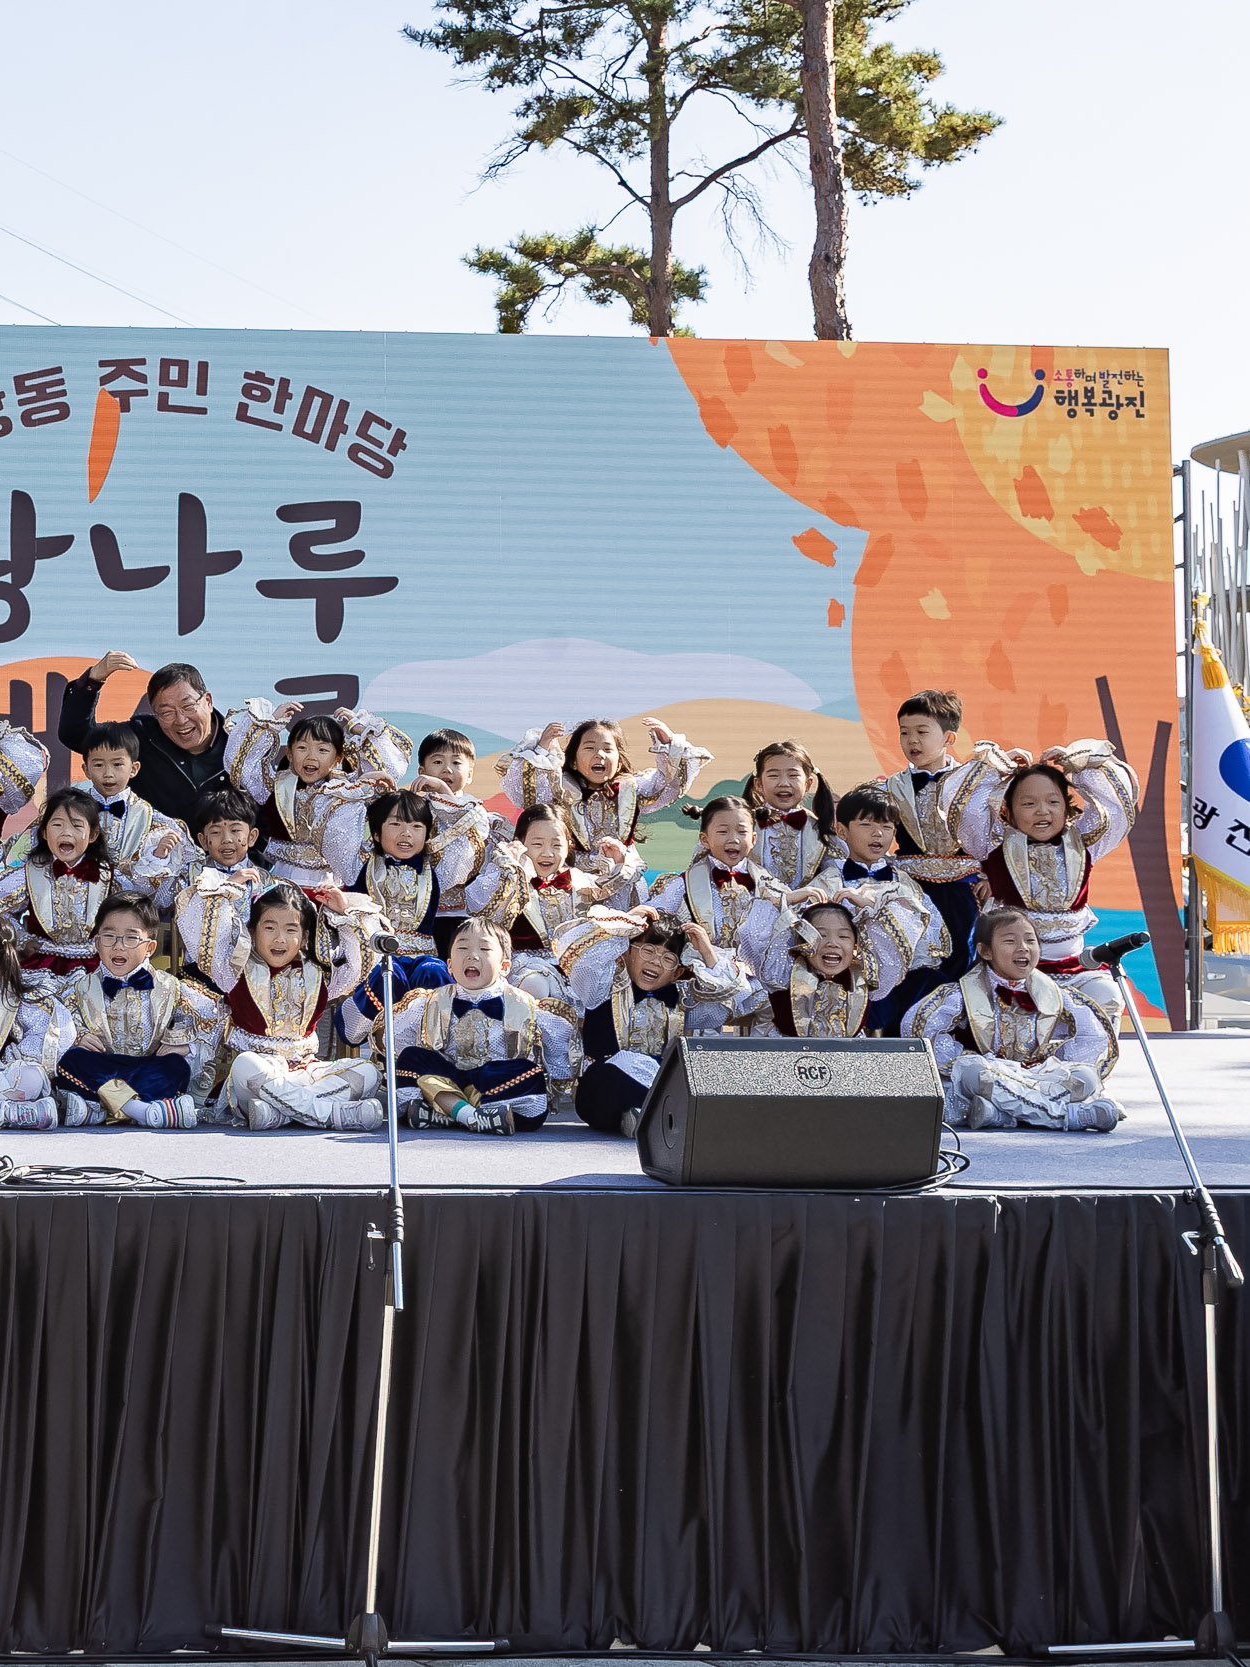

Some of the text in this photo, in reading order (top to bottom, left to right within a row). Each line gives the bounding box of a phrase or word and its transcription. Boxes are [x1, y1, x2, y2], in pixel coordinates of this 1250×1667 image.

[1053, 368, 1145, 389] 소통하며 발전하는
[1053, 386, 1145, 421] 행복광진
[98, 357, 209, 415] 주민
[235, 370, 408, 480] 한마당
[797, 1065, 827, 1080] RCF
